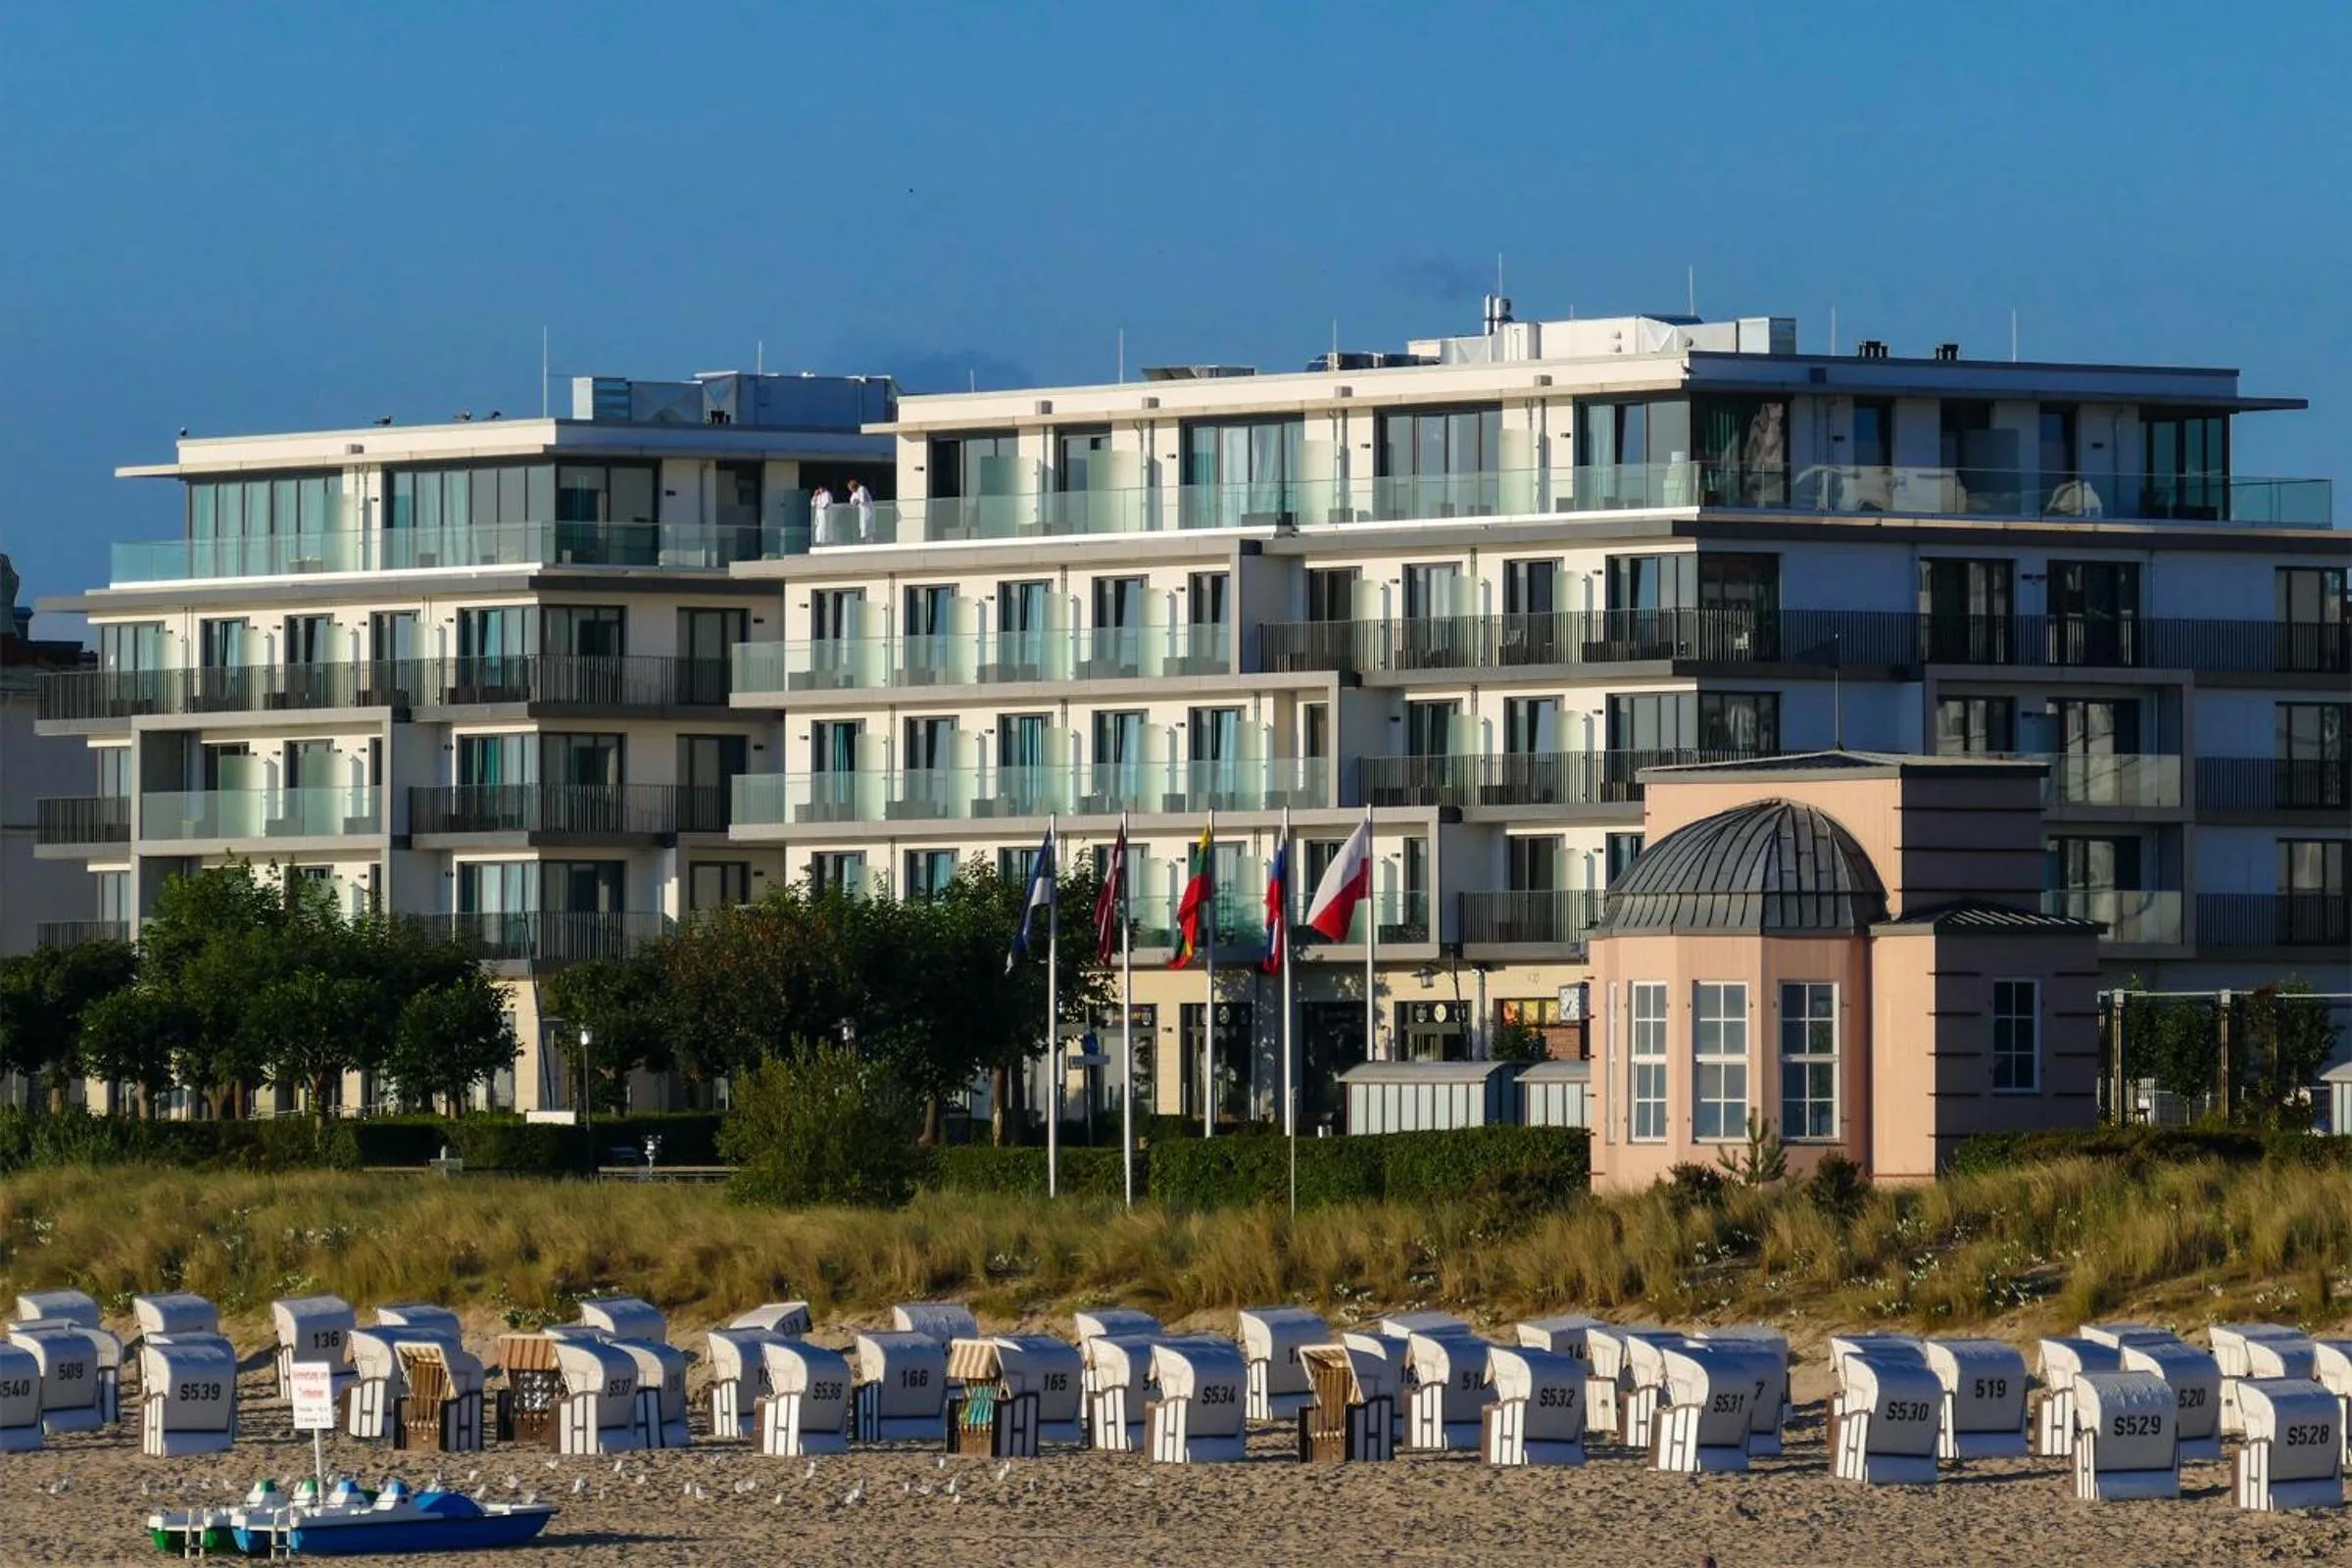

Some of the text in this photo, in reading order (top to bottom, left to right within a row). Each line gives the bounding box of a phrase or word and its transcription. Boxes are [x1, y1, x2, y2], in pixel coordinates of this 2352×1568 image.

[314, 1331, 339, 1349] 136
[902, 1369, 928, 1389] 166
[1043, 1373, 1067, 1392] 165
[1975, 1379, 2007, 1399] 519
[179, 1383, 221, 1401] S539
[1201, 1386, 1236, 1405] S534
[1539, 1387, 1575, 1408] S532
[2179, 1387, 2206, 1408] 520
[1712, 1394, 1744, 1414] S531
[1886, 1400, 1930, 1422] S530
[2113, 1414, 2162, 1437] S529
[2286, 1424, 2329, 1446] S528
